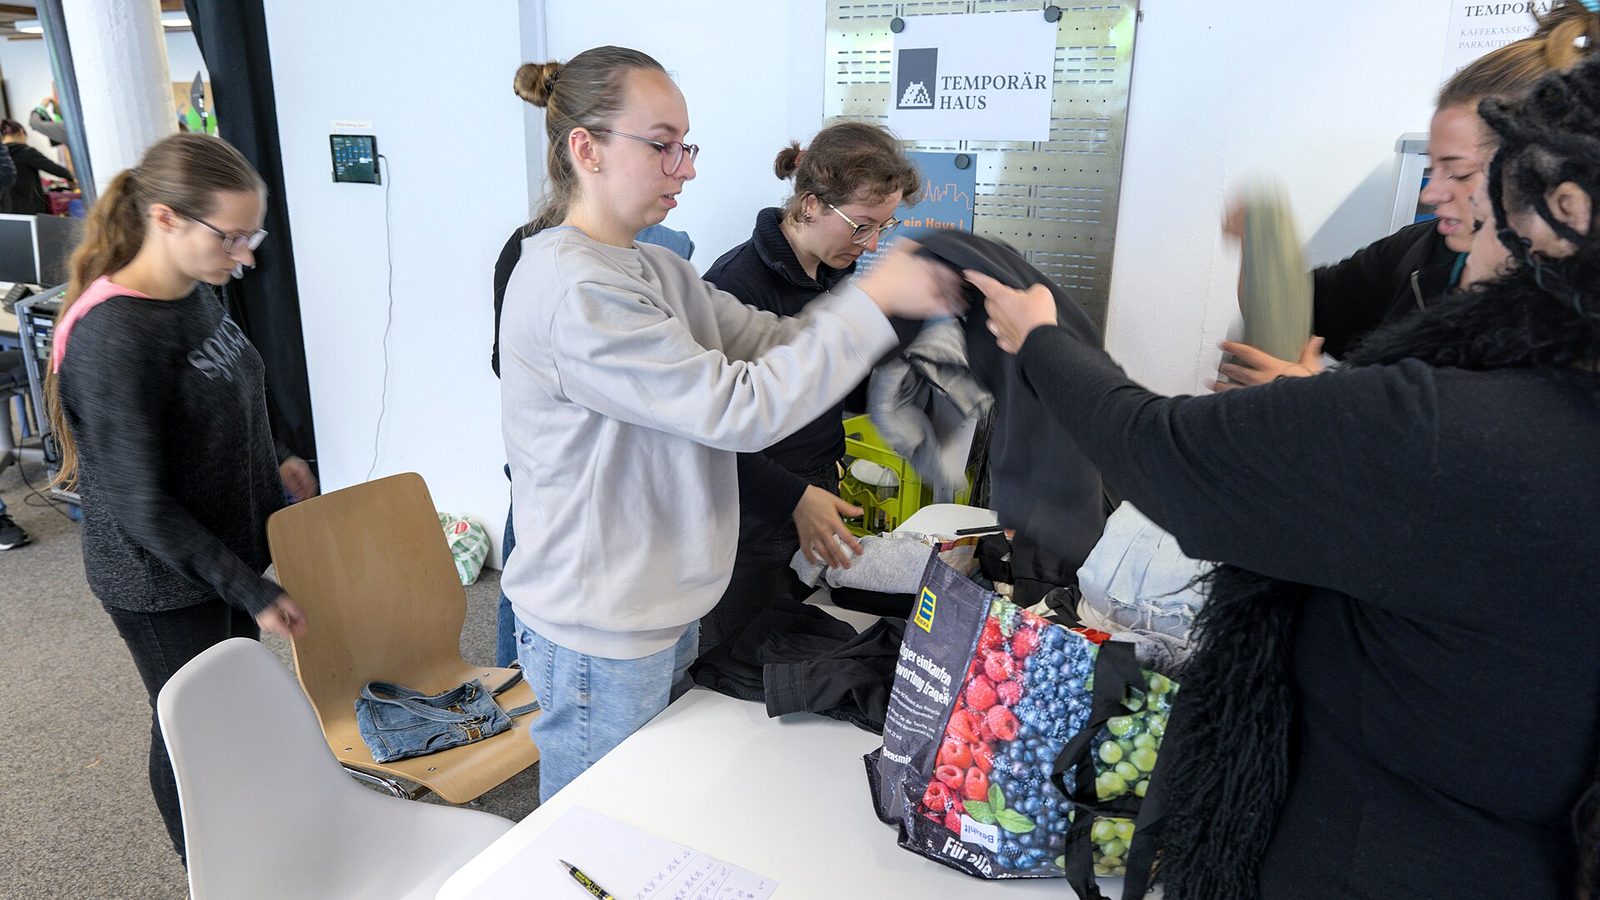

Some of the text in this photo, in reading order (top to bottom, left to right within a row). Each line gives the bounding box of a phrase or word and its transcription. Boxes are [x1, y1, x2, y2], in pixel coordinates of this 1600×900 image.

[1458, 39, 1514, 49] PARKAUTO
[941, 72, 1047, 90] TEMPORÄR
[940, 95, 986, 110] HAUS
[903, 216, 922, 227] ein
[925, 217, 955, 229] Haus
[916, 655, 951, 687] einkaufen
[942, 836, 968, 860] Für
